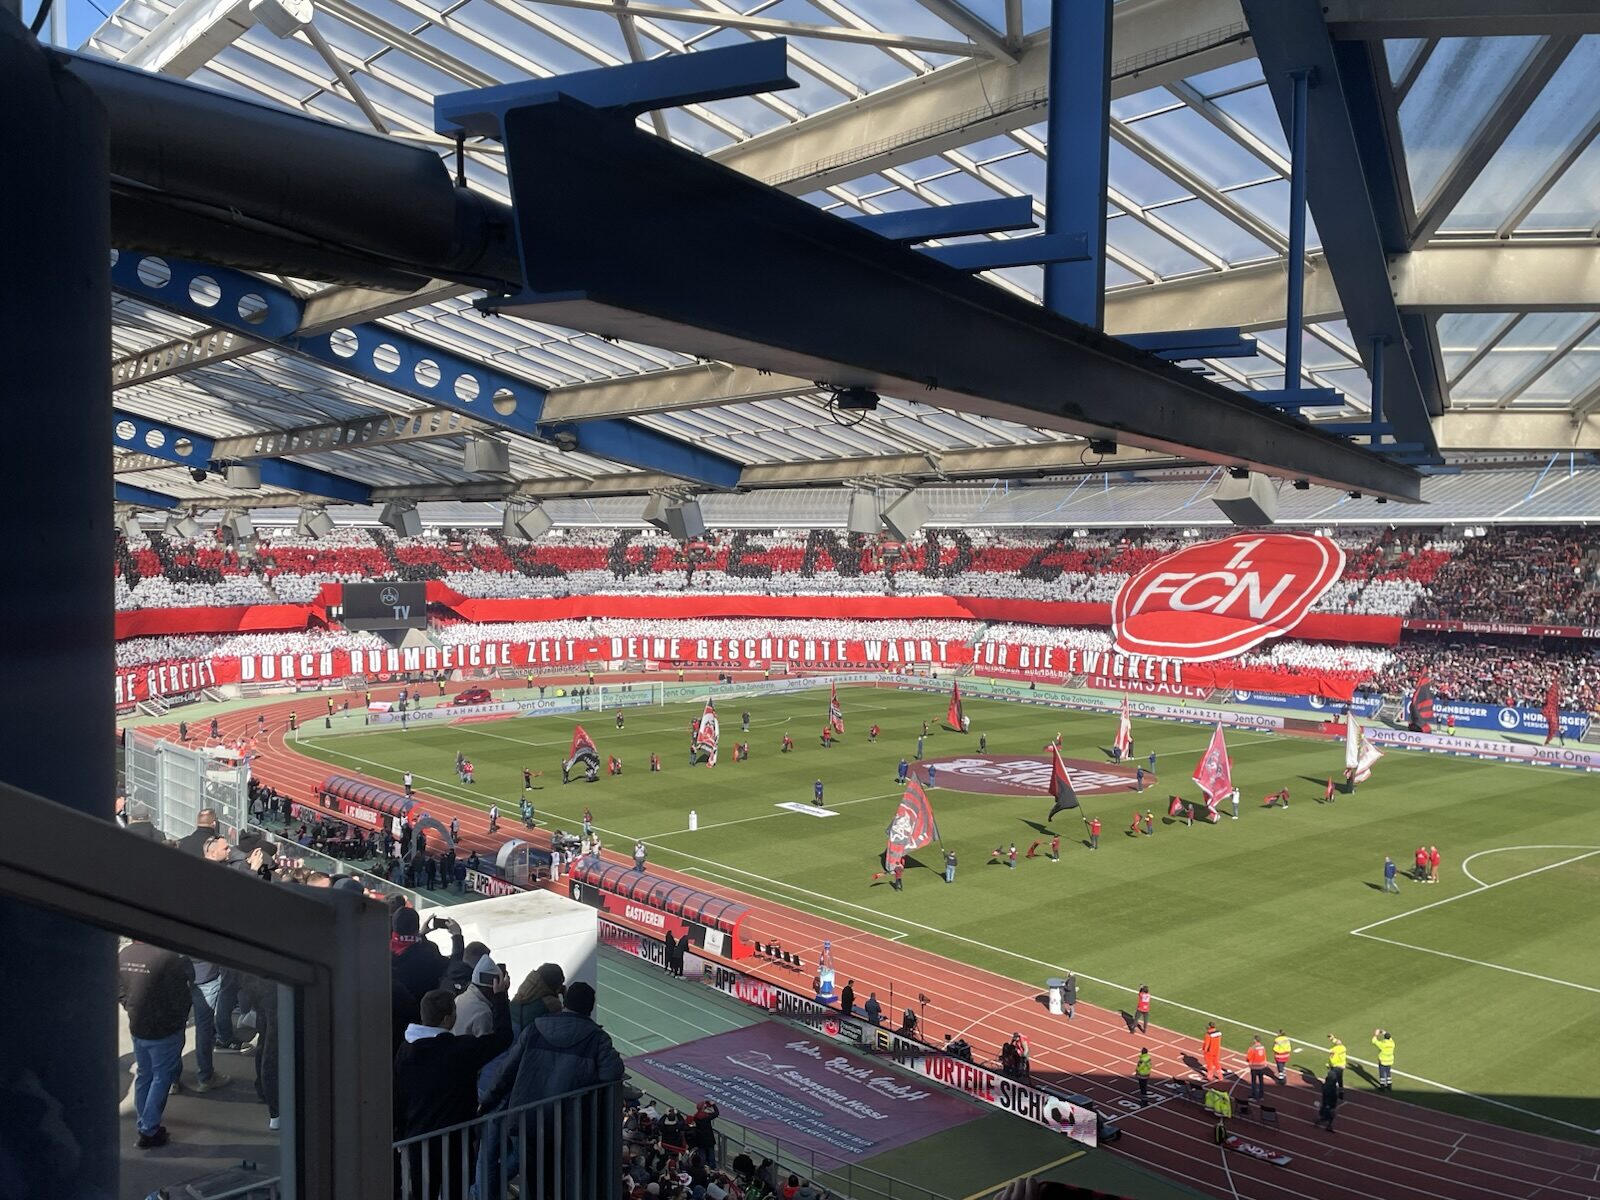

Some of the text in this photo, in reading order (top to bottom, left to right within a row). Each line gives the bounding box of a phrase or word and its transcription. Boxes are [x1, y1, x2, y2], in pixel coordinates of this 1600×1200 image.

[1224, 538, 1266, 569] 1.
[1130, 571, 1296, 619] FCN
[393, 605, 411, 620] TV
[1463, 622, 1491, 633] bisping
[1498, 624, 1528, 635] bisping
[147, 659, 215, 697] GEREIFT
[241, 652, 333, 680] DURCH
[350, 643, 512, 674] RUHMREICHE
[527, 640, 575, 663] ZEIT
[611, 637, 680, 660] DEINE
[697, 638, 847, 661] GESCHICHTE
[864, 638, 948, 662] WÄHRT
[974, 639, 1008, 666] FÜR
[1019, 645, 1053, 669] DIE
[1069, 649, 1184, 683] EWIGKEIT
[802, 678, 817, 686] One
[895, 675, 909, 683] One
[680, 687, 696, 697] One
[1007, 687, 1021, 696] One
[446, 704, 506, 716] ZAHNÄRZTE
[538, 699, 555, 708] One
[1138, 702, 1156, 713] One
[412, 711, 433, 721] One
[1167, 706, 1223, 719] ZAHNÄRZTE
[1256, 715, 1276, 727] One
[1398, 731, 1422, 743] One
[1438, 737, 1516, 753] ZAHNÄRZTE
[1563, 750, 1591, 763] One
[625, 904, 666, 928] GASTVEREIN
[714, 966, 736, 994] APP
[784, 1070, 848, 1102] Sebastian
[925, 1056, 995, 1103] VORTEILE
